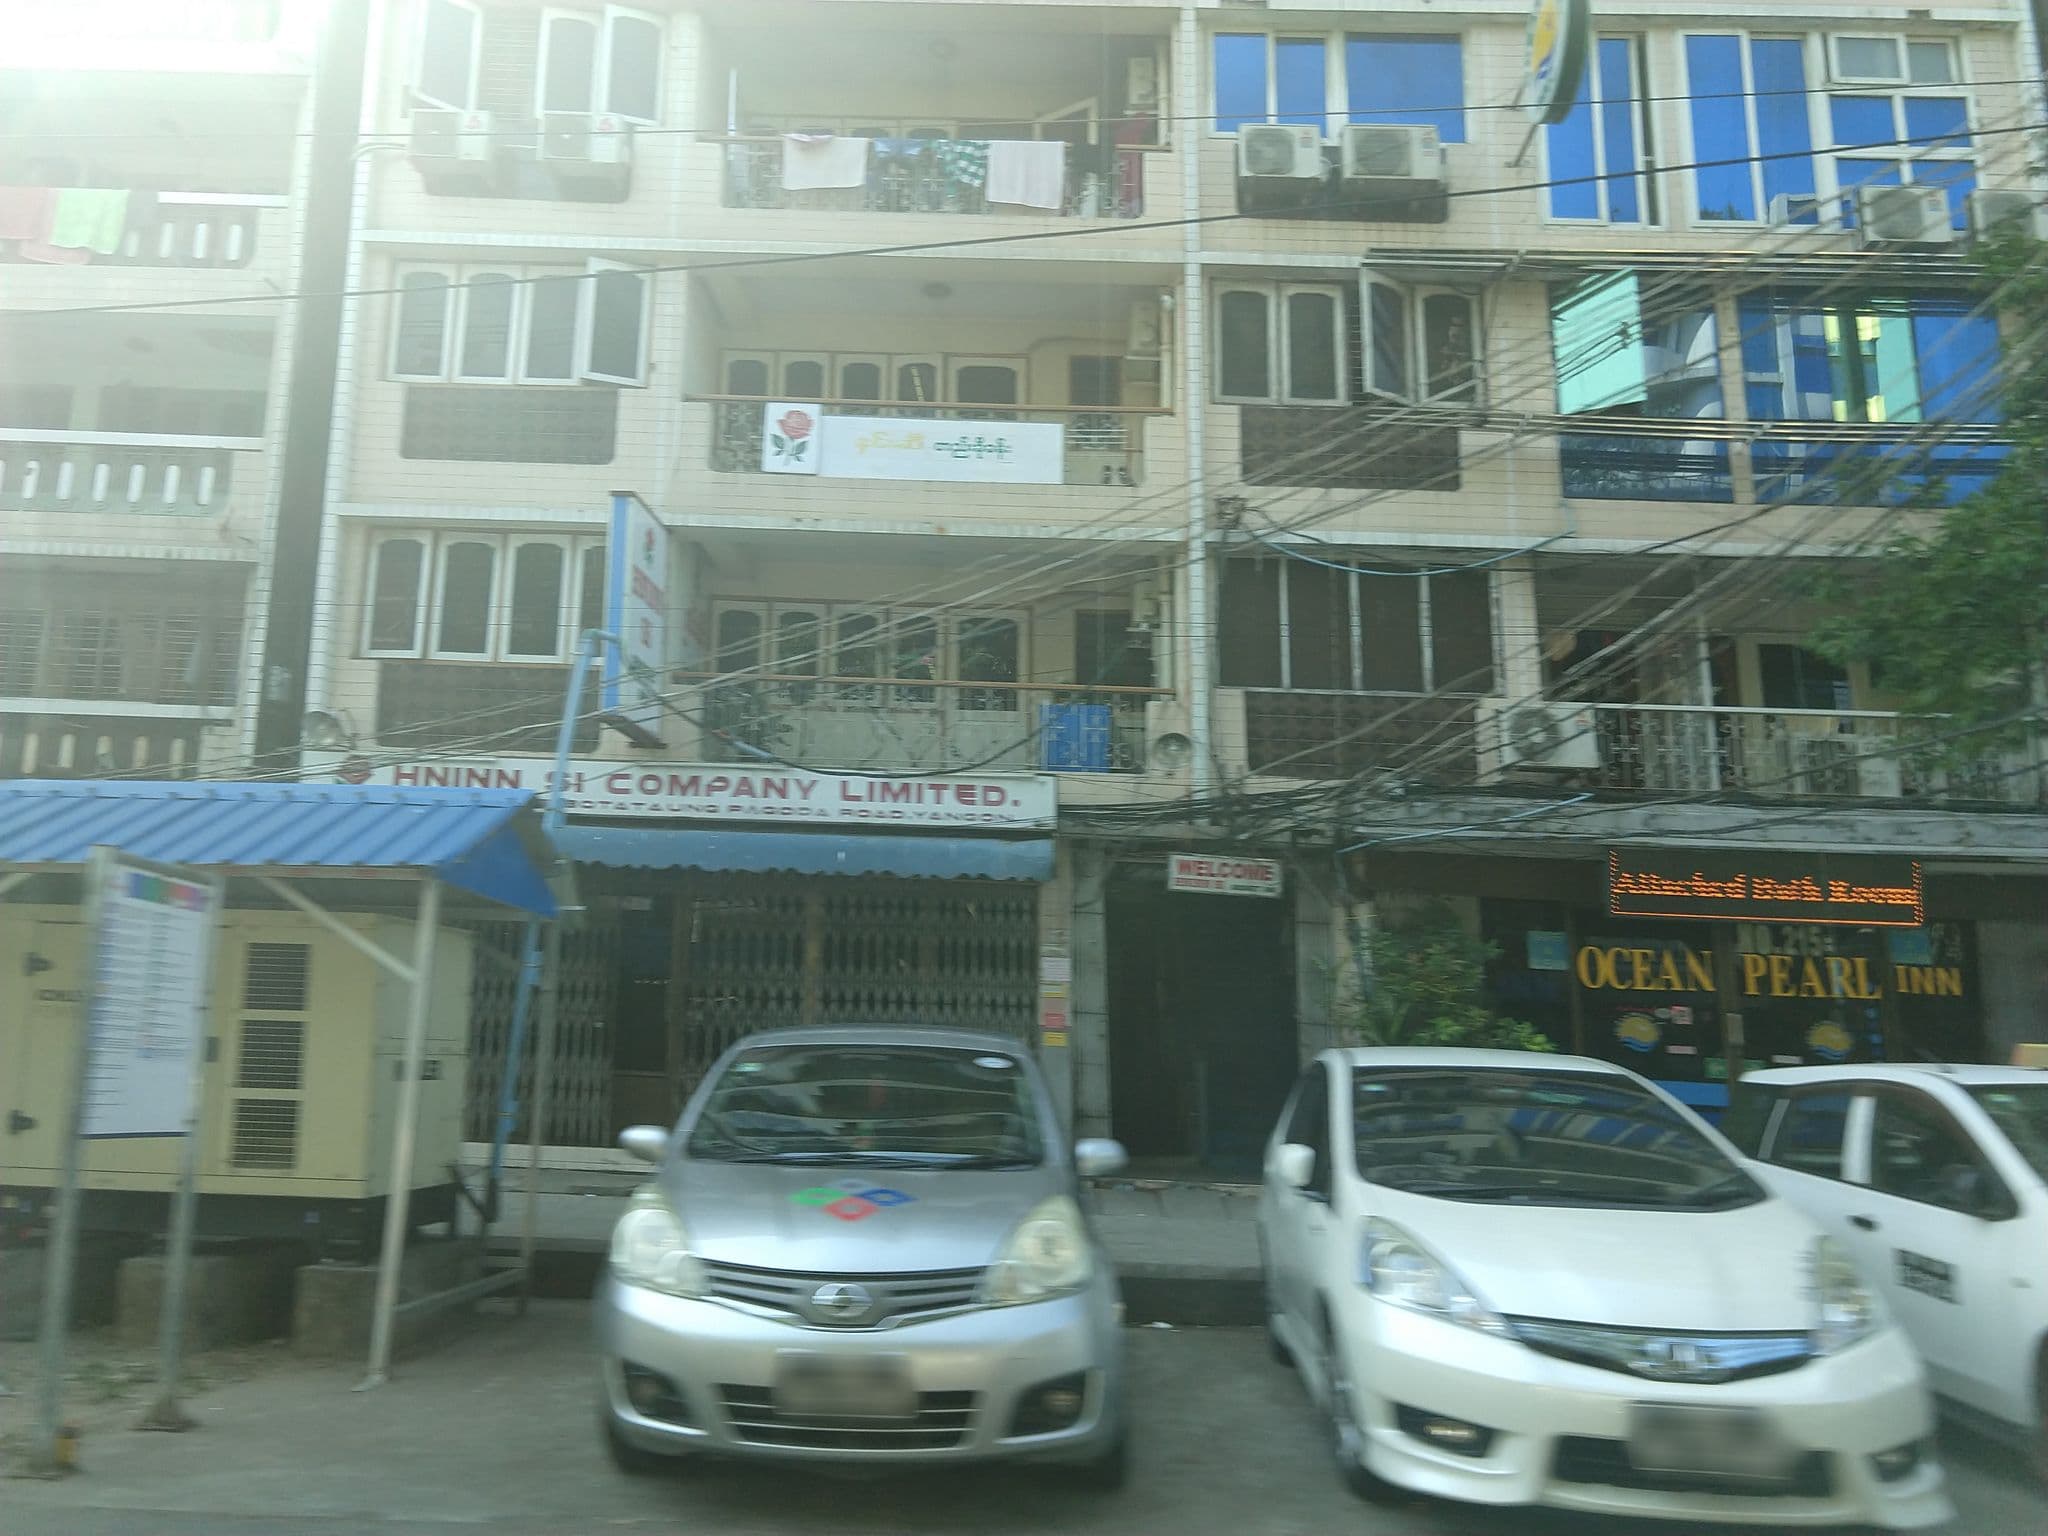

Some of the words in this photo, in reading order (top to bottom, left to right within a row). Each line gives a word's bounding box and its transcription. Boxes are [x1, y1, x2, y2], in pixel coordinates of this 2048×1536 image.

[394, 765, 522, 789] HNINN
[606, 773, 817, 800] COMPANY
[840, 780, 1021, 807] LIMITED.
[1576, 945, 1716, 991] OCEAN
[1741, 953, 1882, 999] PEARL
[1896, 966, 1963, 997] INN
